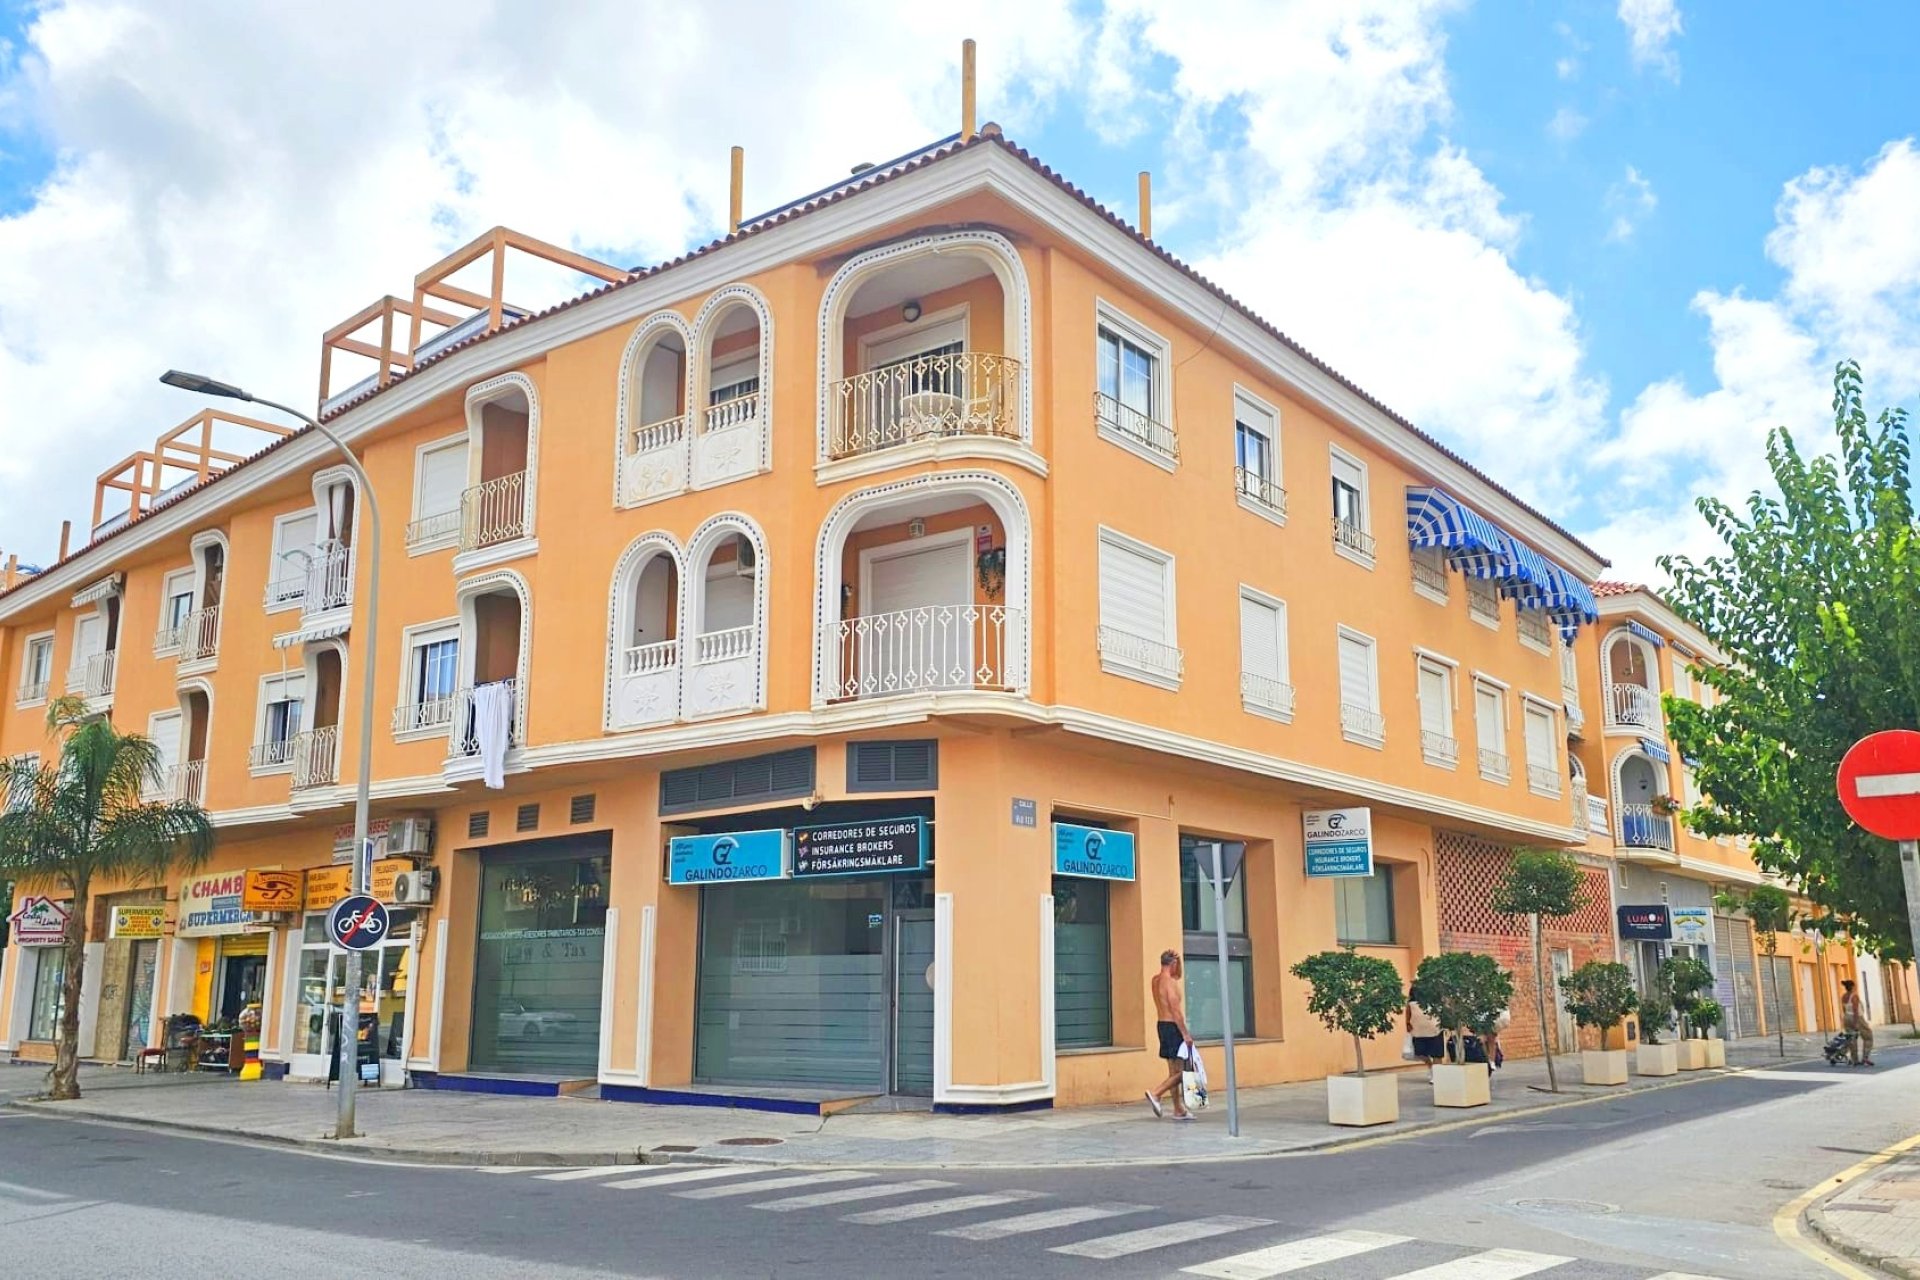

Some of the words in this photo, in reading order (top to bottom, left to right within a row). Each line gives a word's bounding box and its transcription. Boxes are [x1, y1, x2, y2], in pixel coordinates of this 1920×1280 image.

[812, 829, 863, 842] CORREDORES
[866, 827, 876, 837] DE
[879, 823, 916, 836] SEGUROS
[1307, 829, 1366, 839] GALINDOZARCO
[812, 844, 854, 856] INSURANCE
[857, 840, 894, 852] BROKERS
[685, 865, 768, 881] GALINDOZARCO
[1063, 859, 1128, 877] GALINDOZARCO
[192, 875, 243, 899] CHAMB
[118, 908, 164, 916] SUPERMERCADO
